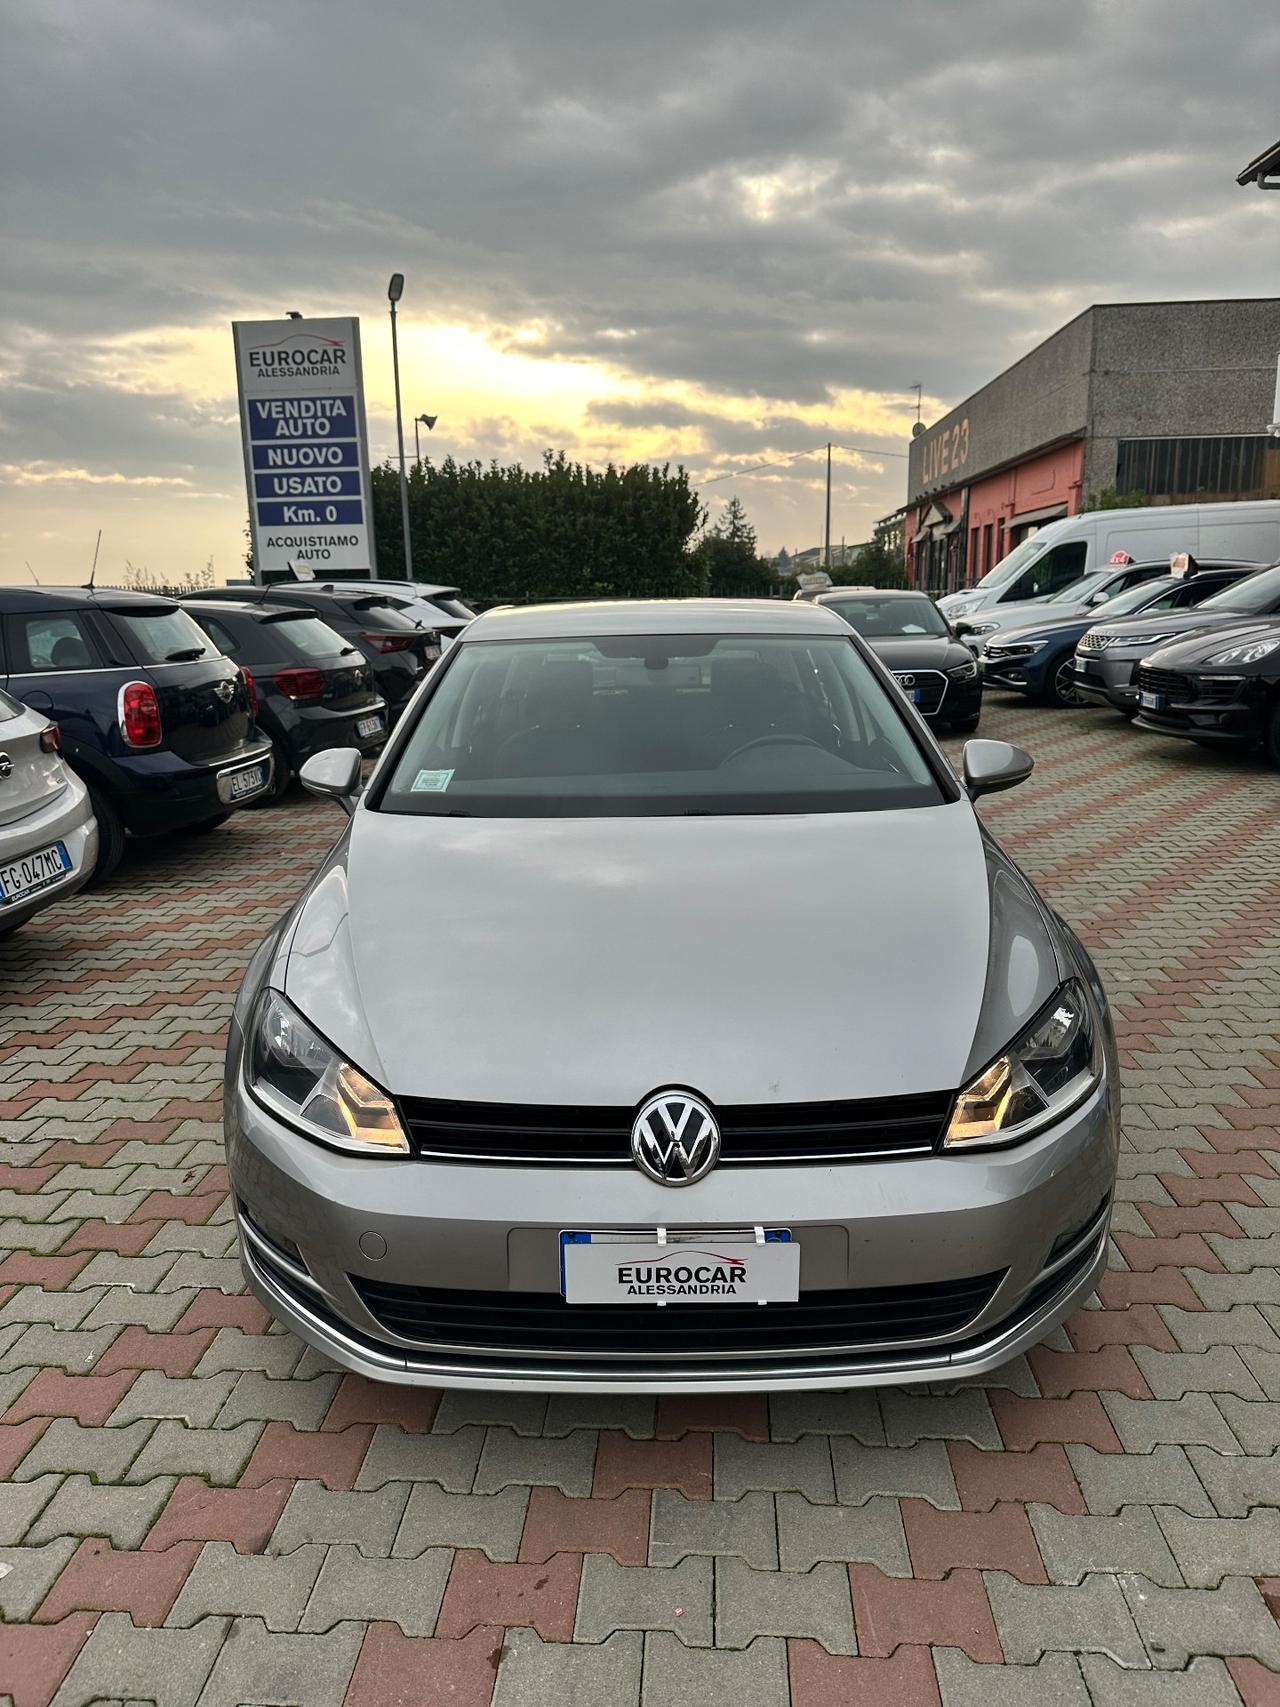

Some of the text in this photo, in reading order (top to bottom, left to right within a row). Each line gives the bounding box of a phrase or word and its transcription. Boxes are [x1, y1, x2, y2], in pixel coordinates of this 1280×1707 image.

[249, 348, 346, 367] EUROCAR
[257, 365, 340, 378] ALESSANDRIA
[256, 399, 347, 419] VENDITA
[275, 417, 331, 437] AUTO
[267, 446, 344, 466] NUOVO
[922, 418, 969, 485] LIVE 23
[273, 475, 342, 495] USATO
[283, 505, 338, 523] Km. 0
[266, 535, 359, 548] ACQUISTIAMO
[296, 548, 331, 561] AUTO
[231, 775, 243, 792] EL
[0, 867, 21, 894] FG
[21, 850, 62, 884] 047MC
[618, 1266, 747, 1284] EUROCAR
[627, 1284, 737, 1295] ALESSANDRIA
